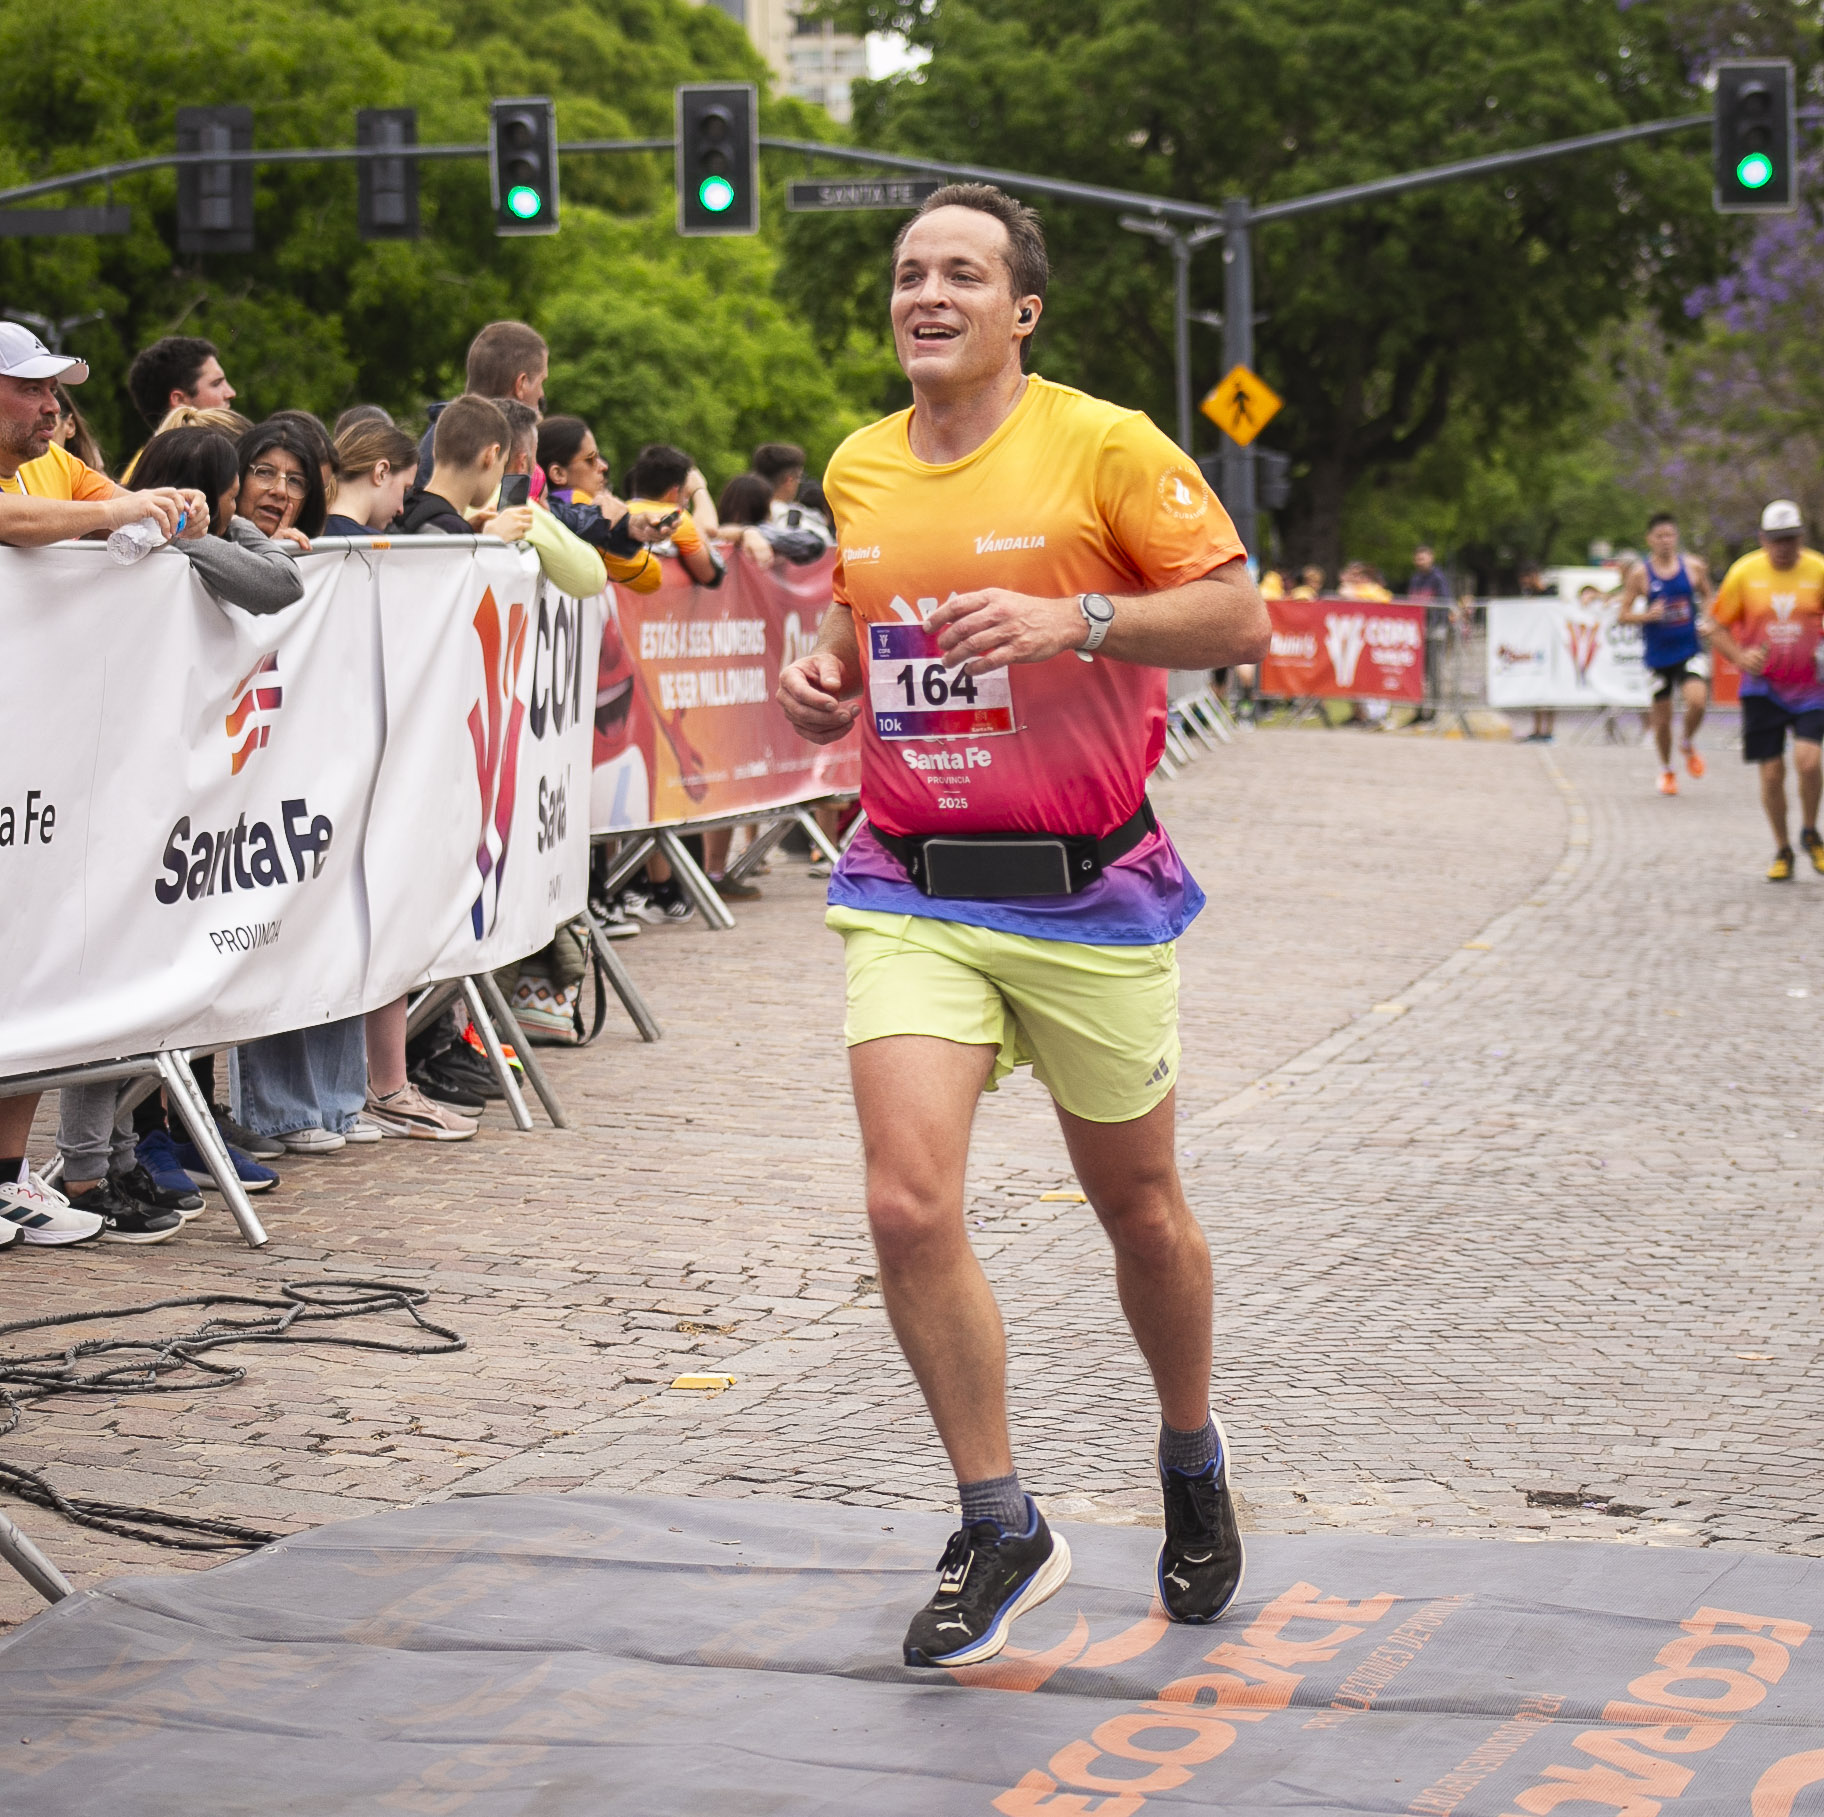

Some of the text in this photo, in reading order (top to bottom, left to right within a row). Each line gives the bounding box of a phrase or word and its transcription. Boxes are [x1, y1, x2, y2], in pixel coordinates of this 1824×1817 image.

[871, 545, 881, 560] 6
[974, 530, 1045, 554] VANDALIA
[897, 663, 978, 706] 164
[879, 719, 902, 732] 10k
[902, 747, 992, 770] Santa Fe
[927, 776, 971, 785] PROVINCIA
[938, 797, 968, 809] 2025
[0, 790, 56, 847] a Fe
[155, 798, 333, 905] Santa Fe
[209, 920, 282, 954] PROVINCIA
[991, 1581, 1404, 1817] ECORACE
